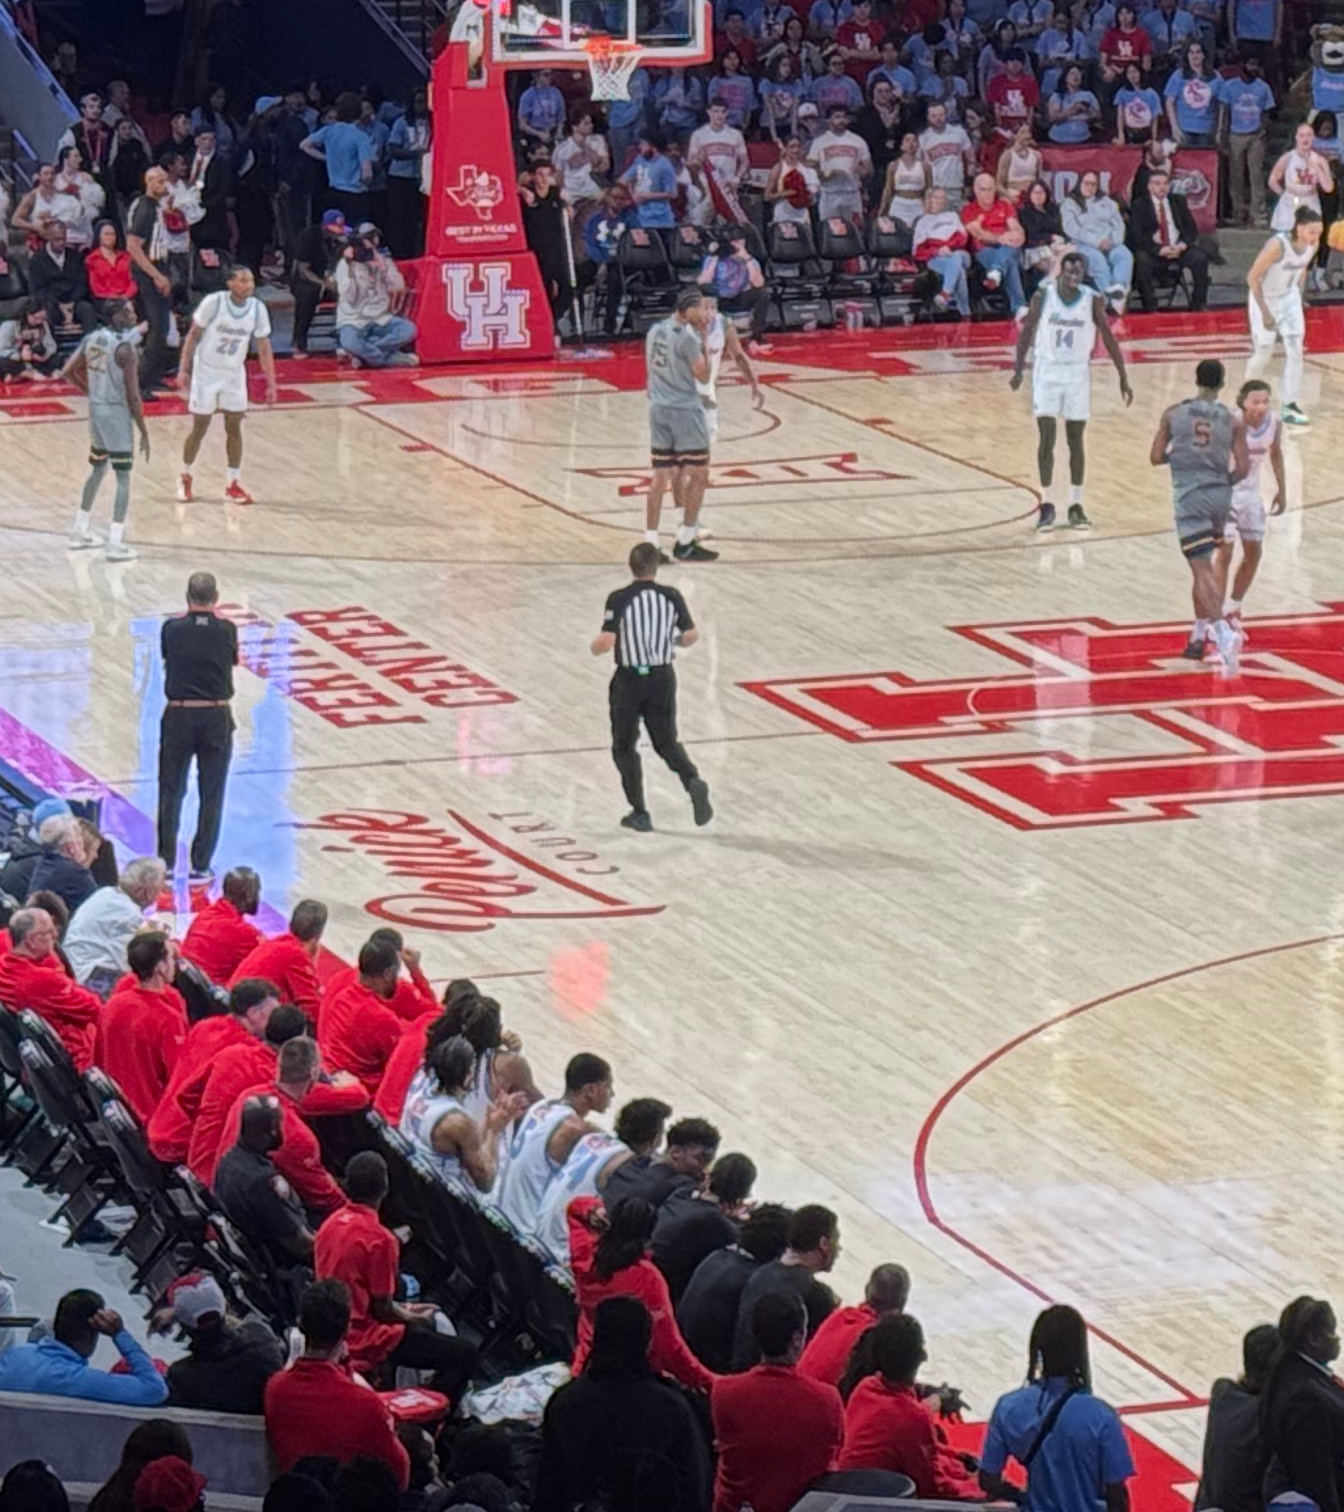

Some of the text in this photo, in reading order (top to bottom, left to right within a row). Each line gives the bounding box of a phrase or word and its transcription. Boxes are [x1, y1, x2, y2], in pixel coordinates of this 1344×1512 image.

[442, 261, 531, 350] UH
[283, 605, 522, 709] CENTER
[488, 810, 621, 876] COURT
